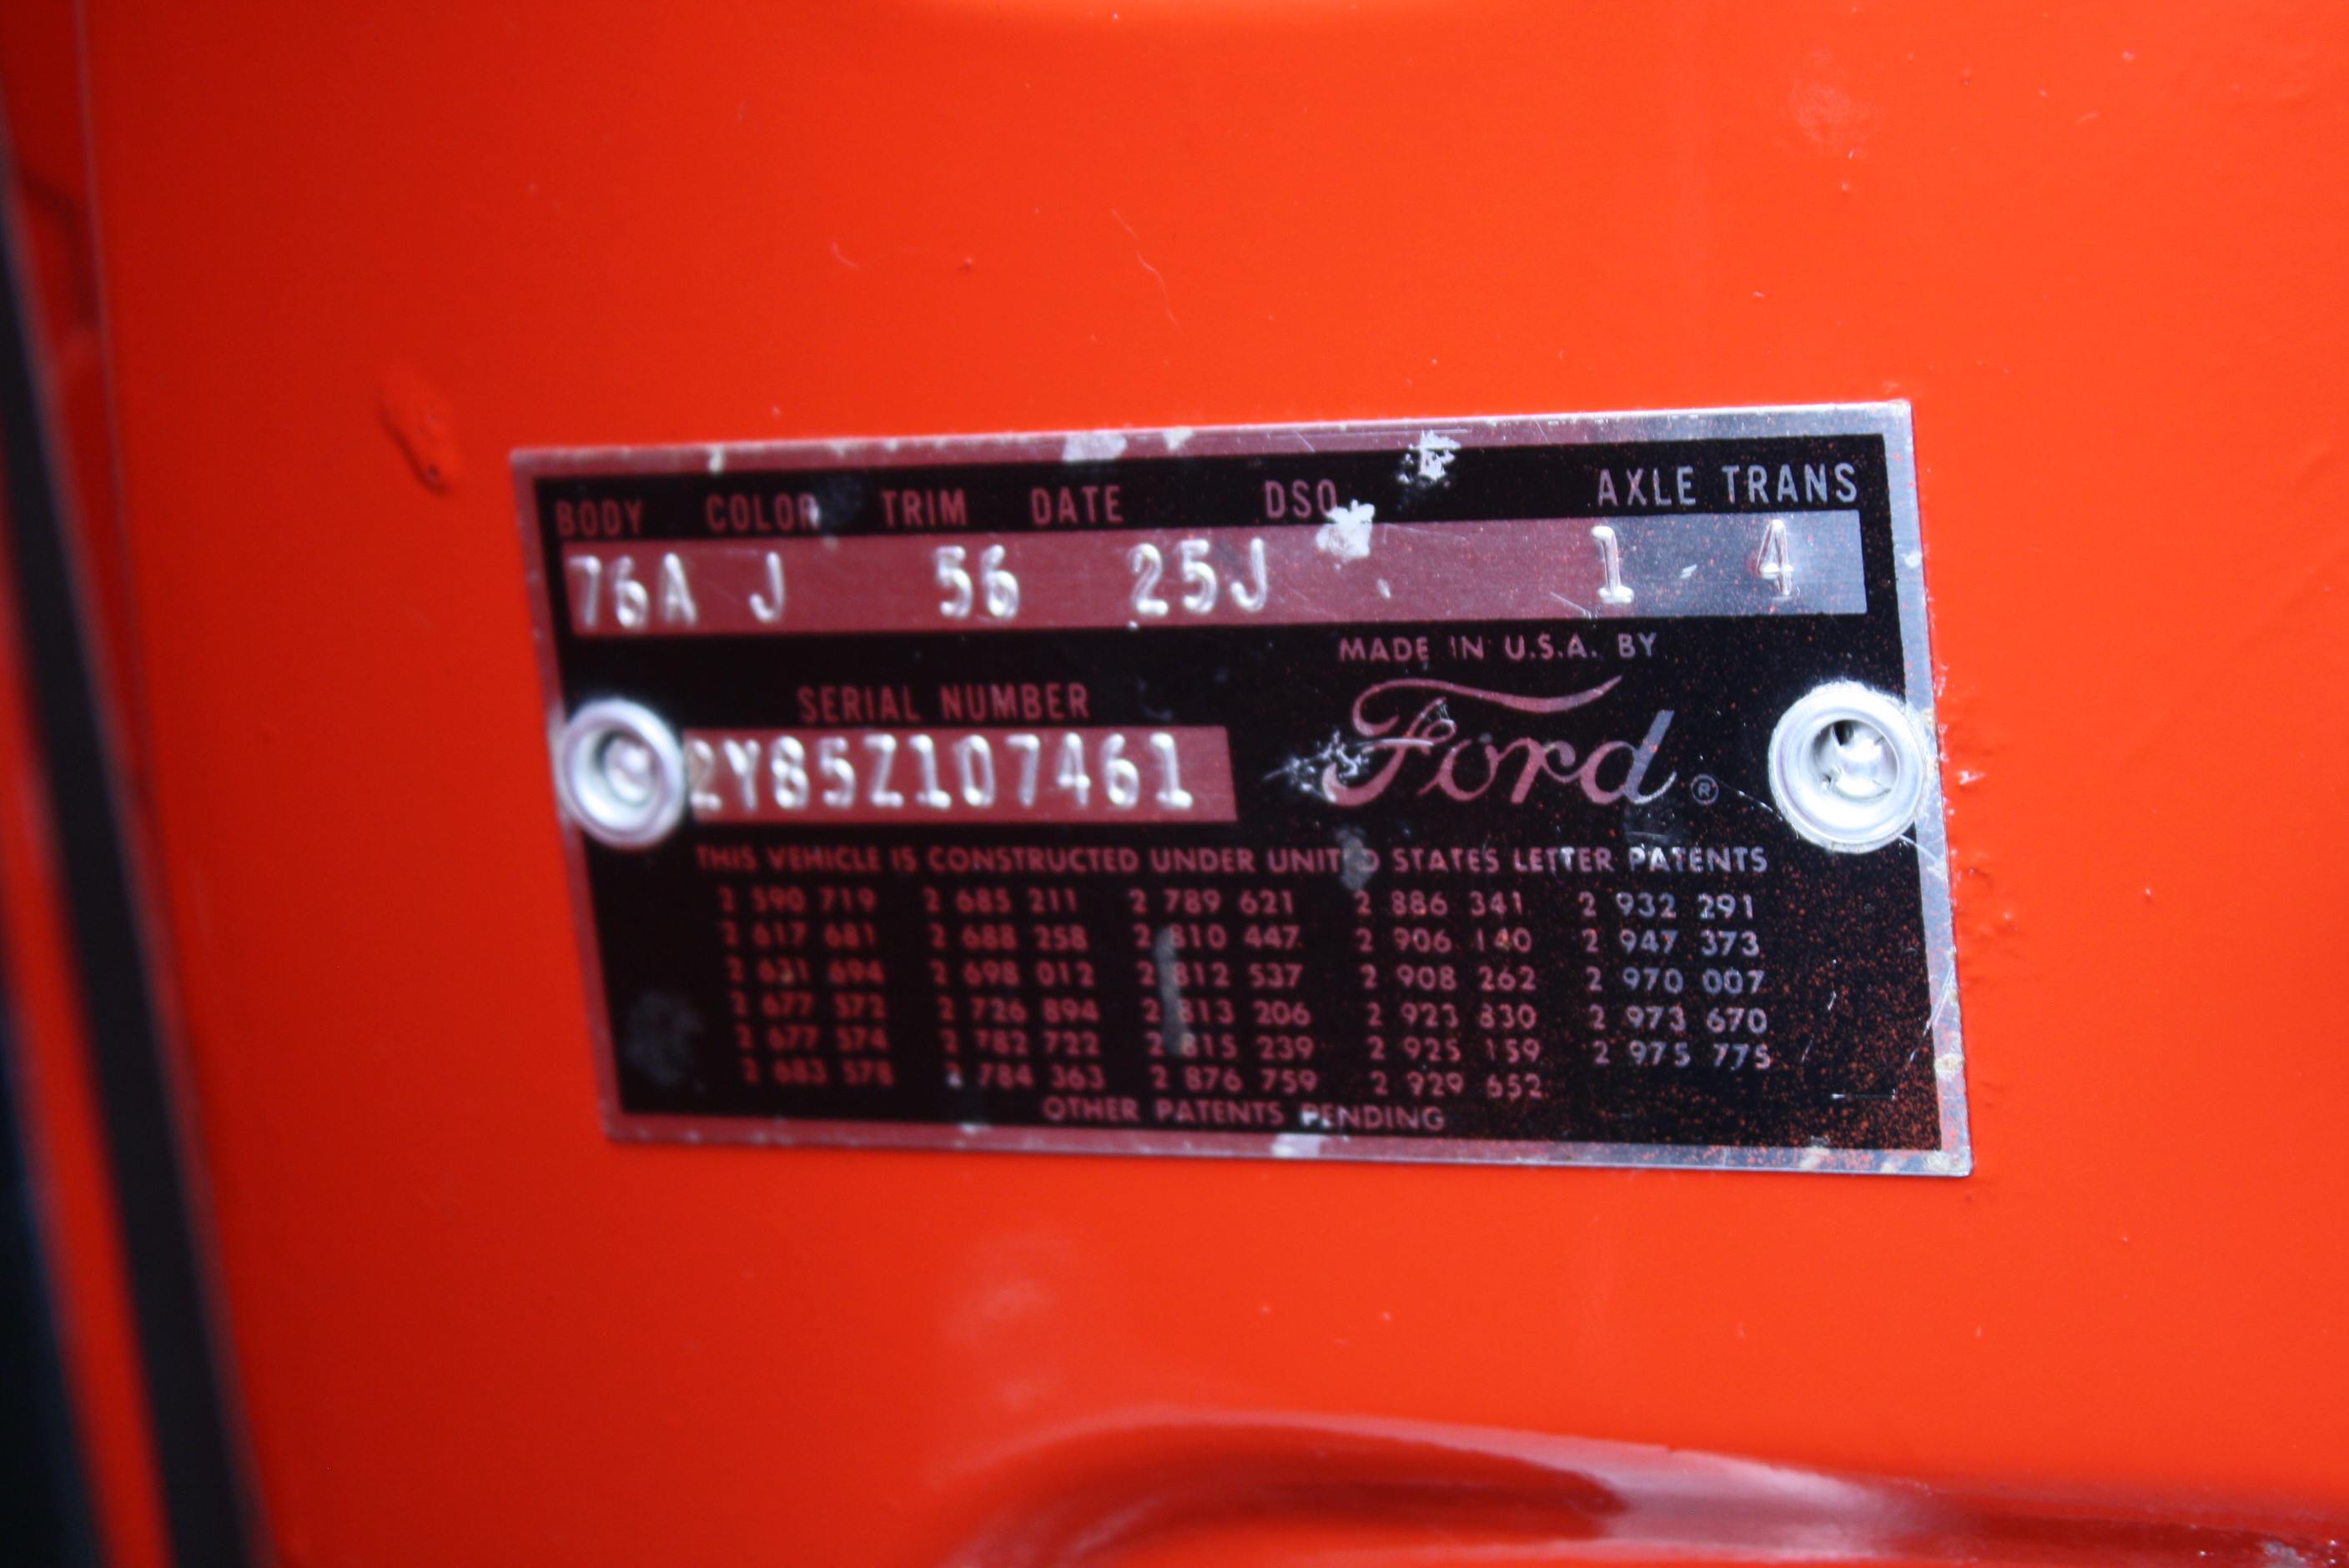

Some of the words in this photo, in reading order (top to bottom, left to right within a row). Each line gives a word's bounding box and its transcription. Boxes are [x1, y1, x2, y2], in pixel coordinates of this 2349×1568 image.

[556, 500, 645, 537] BODY
[707, 493, 822, 532] COLOR
[882, 490, 967, 526] TRIM
[1031, 485, 1123, 525] DATE
[1265, 480, 1339, 521] DSO
[1598, 465, 1696, 505] AXLE
[1722, 462, 1858, 503] TRANS
[568, 553, 697, 629] 76A
[750, 551, 786, 623] J
[934, 545, 1021, 619] 56
[1130, 539, 1268, 614] 25J
[1591, 525, 1634, 604] 1
[1758, 519, 1794, 603] 4
[1340, 637, 1429, 661] MADE
[1450, 636, 1484, 659] IN
[1505, 632, 1597, 661] U.S.A.
[1618, 632, 1657, 658] BY
[797, 686, 921, 725] SERIAL
[941, 683, 1089, 721] NUMBER
[1321, 676, 1677, 807] Ford
[697, 845, 757, 872] THIS
[767, 846, 881, 872] VEHICLE
[891, 847, 918, 872] IS
[928, 847, 1139, 873] CONSTRUCTED
[1150, 848, 1255, 873] UNDER
[1392, 845, 1499, 873] STATES
[1513, 846, 1613, 873] LETTER
[1629, 843, 1768, 872] PATENTS
[719, 887, 736, 912] 2
[819, 887, 877, 912] 719
[923, 887, 941, 912] 2
[956, 888, 1011, 913] 685
[1029, 887, 1077, 913] 211
[1129, 888, 1147, 914] 2
[1164, 889, 1221, 914] 789
[1239, 889, 1293, 915] 621
[1351, 887, 1371, 916] 2
[1391, 890, 1448, 917] 886
[1470, 891, 1522, 917] 341
[1578, 892, 1597, 917] 2
[1616, 892, 1677, 918] 932
[1698, 893, 1753, 919] 291
[722, 920, 739, 947] 2
[930, 922, 947, 948] 2
[1034, 925, 1088, 951] 258
[1134, 923, 1152, 948] 2
[1167, 923, 1227, 951] 810
[1245, 925, 1300, 949] 447
[1356, 927, 1373, 952] 2
[1394, 927, 1452, 953] 906
[1476, 927, 1532, 952] 140
[1582, 928, 1599, 952] 2
[1619, 929, 1678, 953] 947
[1702, 929, 1759, 957] 373
[727, 956, 744, 983] 2
[930, 960, 948, 985] 2
[963, 960, 1020, 986] 698
[1036, 961, 1094, 987] 012
[1137, 961, 1155, 986] 2
[1171, 960, 1230, 990] 812
[1249, 962, 1303, 988] 537
[1360, 963, 1377, 988] 2
[1396, 964, 1457, 991] 908
[1479, 966, 1536, 992] 262
[1587, 966, 1602, 992] 2
[1622, 967, 1683, 994] 970
[1703, 967, 1765, 995] 007
[730, 990, 748, 1017] 2
[938, 996, 955, 1021] 2
[971, 997, 1028, 1023] 726
[1043, 998, 1099, 1023] 894
[1142, 998, 1160, 1023] 2
[1175, 997, 1235, 1027] 813
[1254, 1000, 1311, 1027] 206
[1367, 1002, 1383, 1028] 2
[1401, 1003, 1459, 1028] 923
[1479, 1003, 1537, 1030] 830
[1589, 1004, 1606, 1030] 2
[1626, 1003, 1686, 1034] 973
[1707, 1007, 1768, 1034] 670
[736, 1023, 753, 1049] 2
[941, 1028, 958, 1054] 2
[1044, 1030, 1099, 1056] 722
[1146, 1031, 1164, 1057] 2
[1257, 1035, 1314, 1060] 239
[1367, 1035, 1385, 1060] 2
[1403, 1036, 1461, 1063] 925
[1486, 1038, 1542, 1063] 159
[1592, 1040, 1610, 1064] 2
[1629, 1040, 1691, 1067] 975
[1713, 1043, 1773, 1070] 775
[742, 1057, 759, 1083] 2
[979, 1063, 1034, 1088] 784
[1052, 1064, 1105, 1090] 363
[1150, 1064, 1168, 1089] 2
[1185, 1066, 1243, 1093] 876
[1261, 1068, 1319, 1093] 759
[1371, 1070, 1388, 1095] 2
[1406, 1071, 1464, 1097] 929
[1486, 1073, 1543, 1101] 652
[1044, 1096, 1139, 1121] OTHER
[1155, 1098, 1285, 1125] PATENTS
[1300, 1103, 1445, 1131] PENDING
